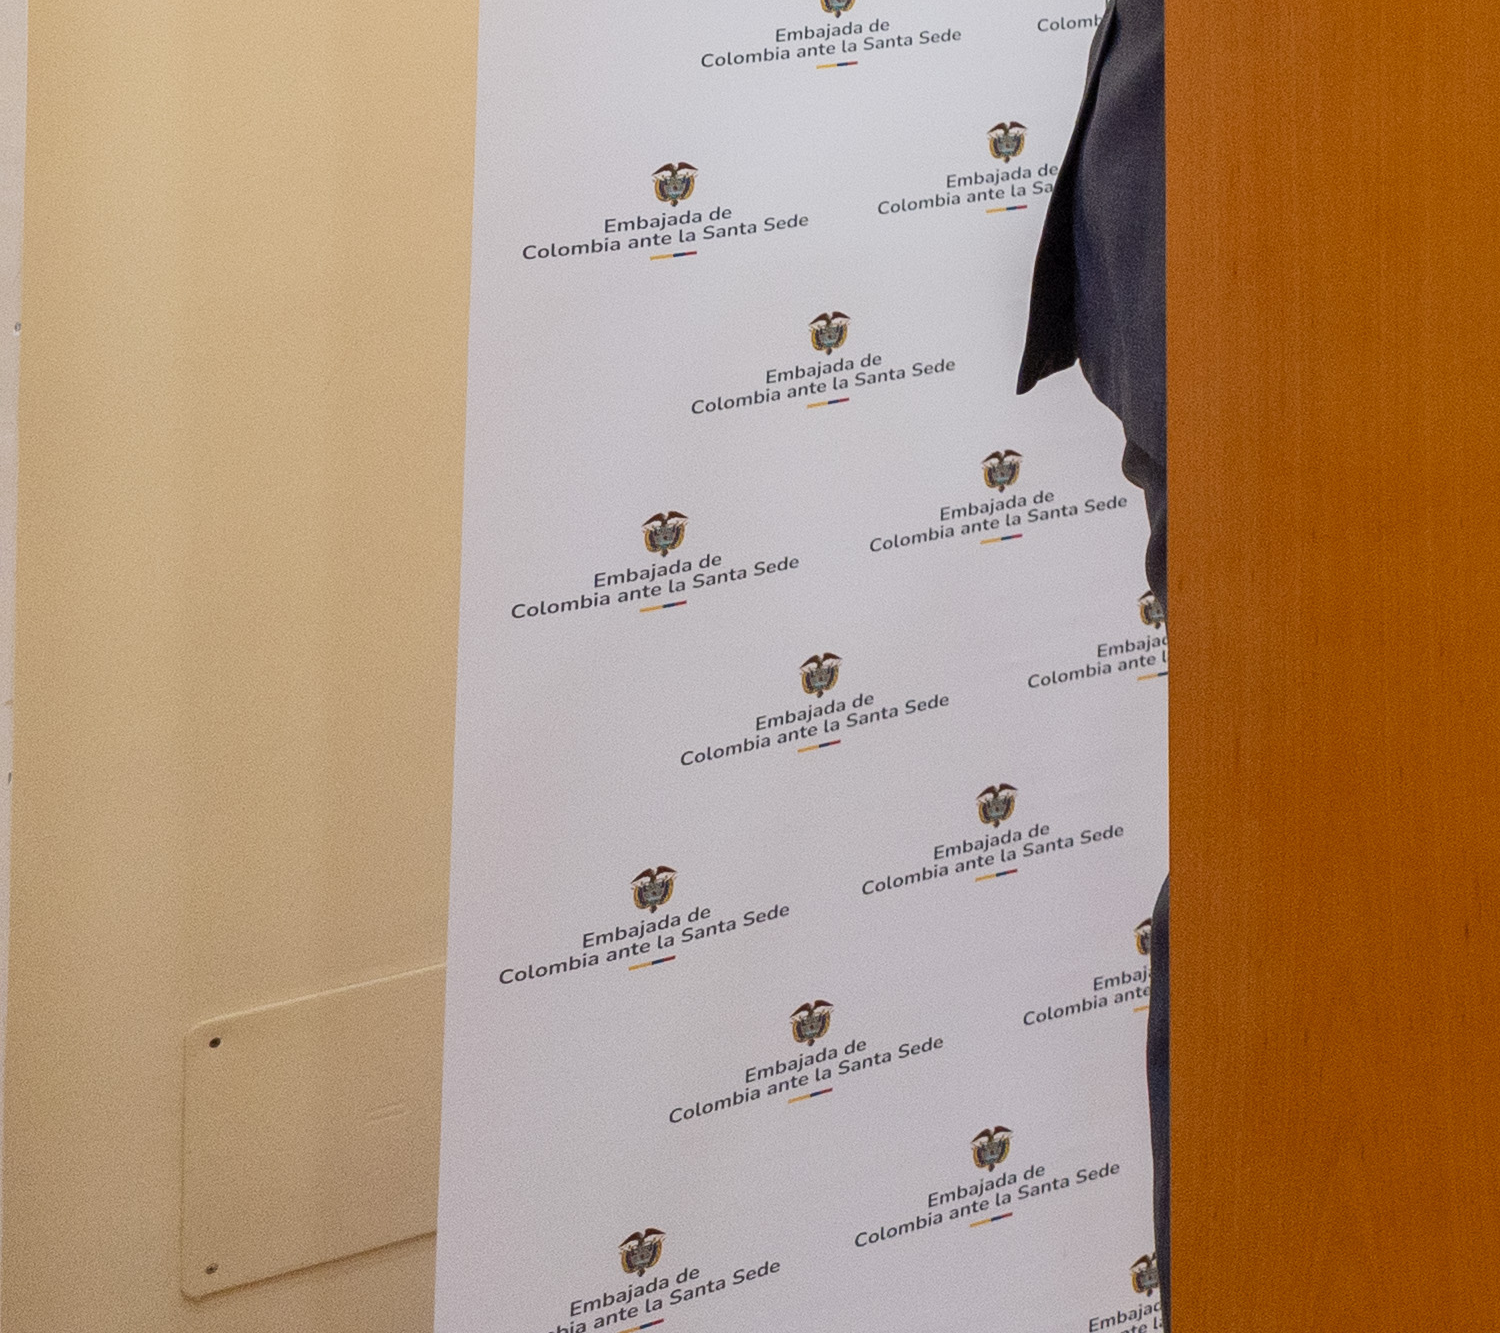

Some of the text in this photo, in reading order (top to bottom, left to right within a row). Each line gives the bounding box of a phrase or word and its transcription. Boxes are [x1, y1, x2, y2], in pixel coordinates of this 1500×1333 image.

[862, 825, 1124, 895] Colombia ante la Santa Sede
[934, 823, 1050, 860] Embajada de
